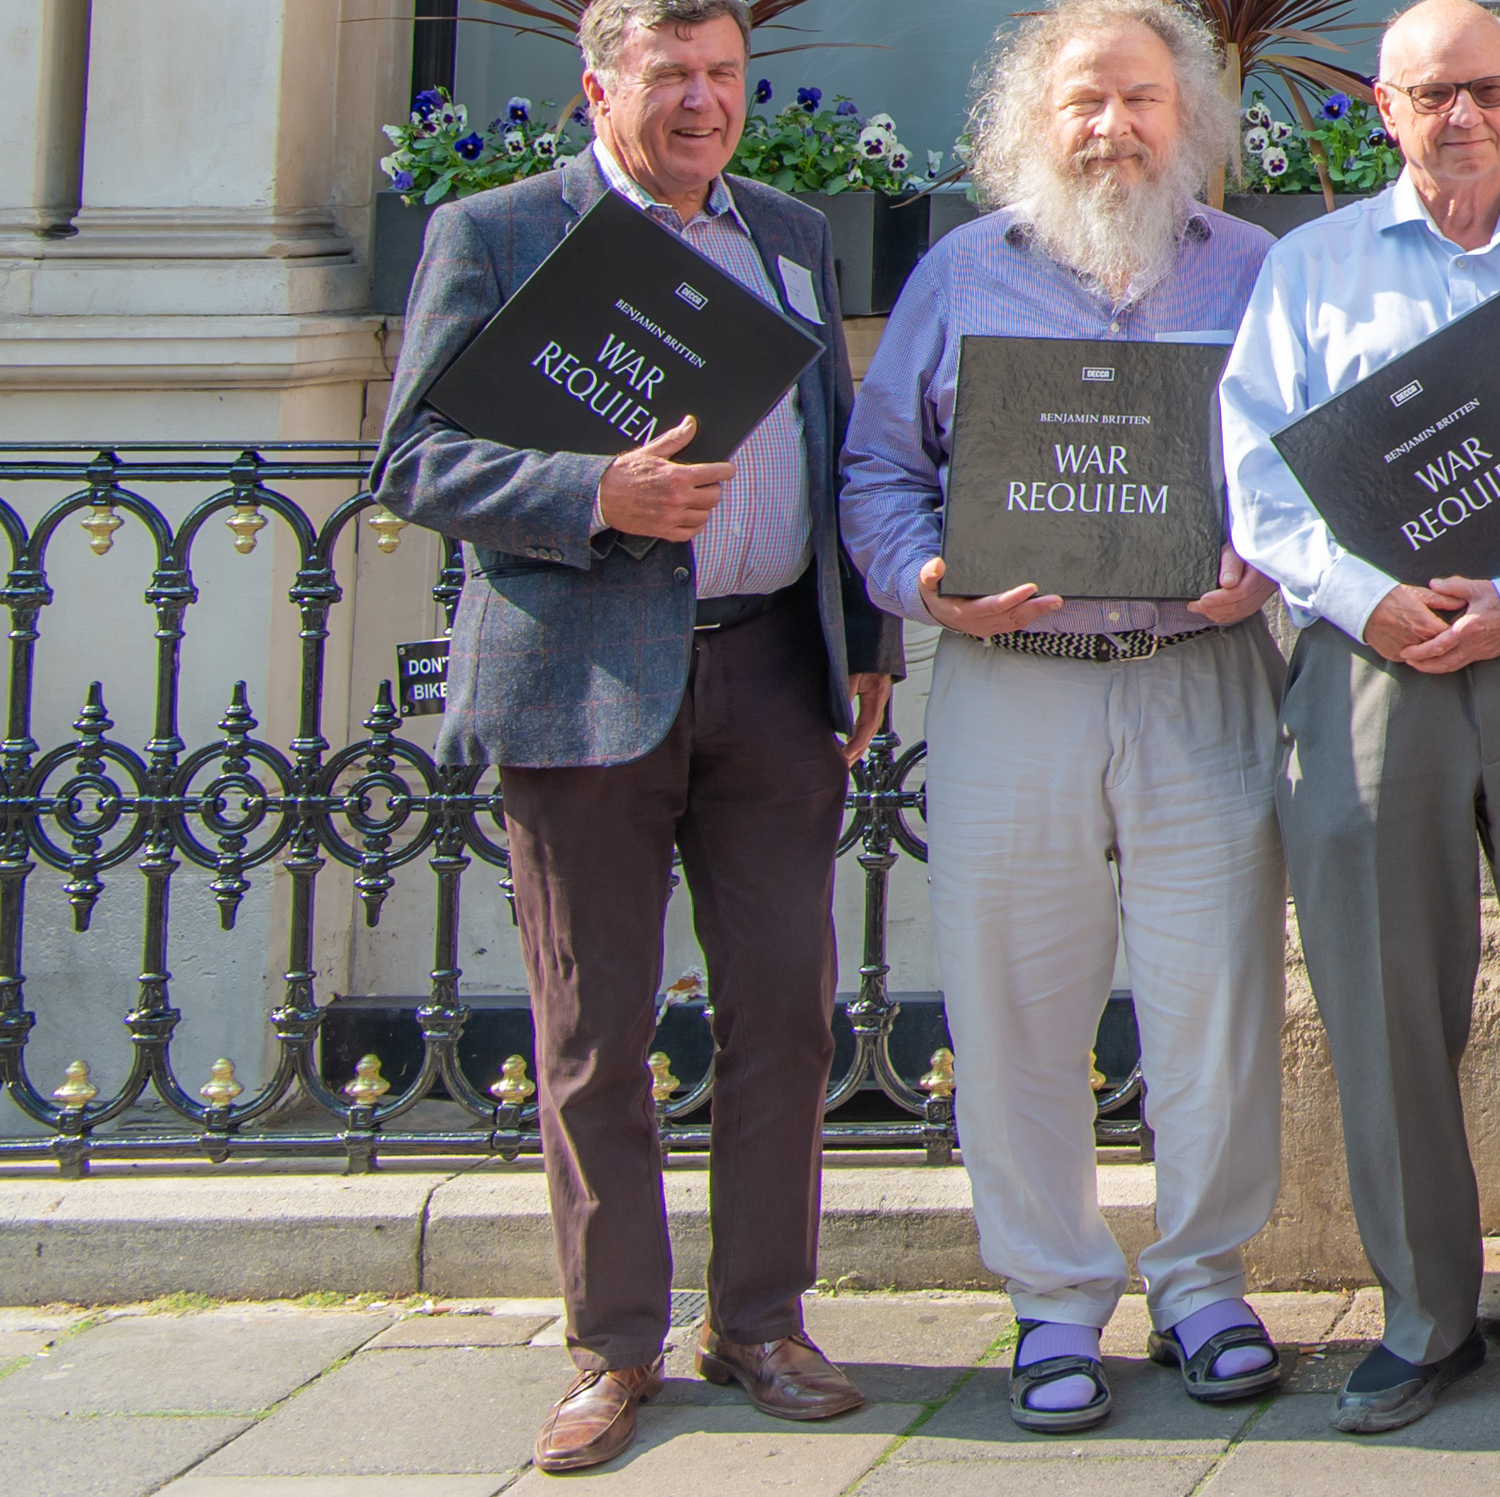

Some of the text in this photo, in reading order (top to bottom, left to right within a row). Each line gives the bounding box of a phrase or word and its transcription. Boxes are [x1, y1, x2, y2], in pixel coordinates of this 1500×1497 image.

[614, 298, 707, 369] BENJAMIN BRITTEN
[596, 332, 666, 400] WAR
[1040, 413, 1151, 425] BENJAMIN BRITTEN
[1383, 397, 1481, 464] BENJAMIN BRITTEN
[1054, 444, 1129, 475] WAR
[1413, 436, 1494, 494] WAR
[1007, 481, 1169, 514] REQUIEM
